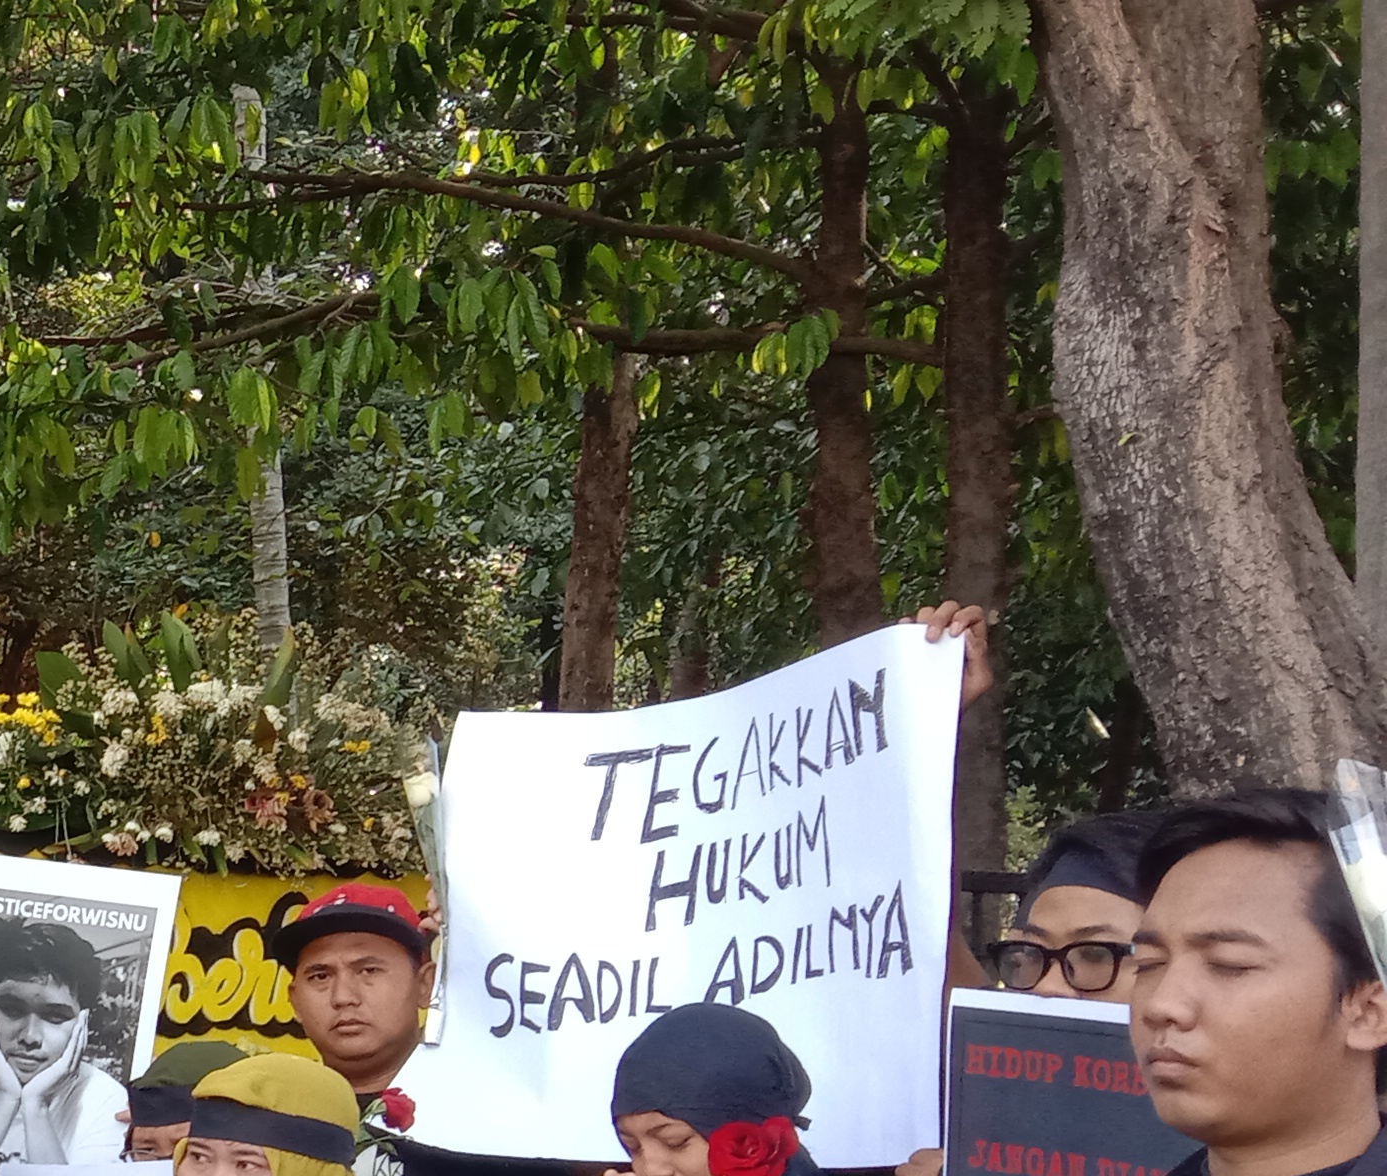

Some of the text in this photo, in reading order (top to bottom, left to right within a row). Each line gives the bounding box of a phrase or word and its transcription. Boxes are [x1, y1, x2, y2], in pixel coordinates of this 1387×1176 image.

[583, 668, 889, 844] TEGAKKAN
[645, 795, 831, 932] HUKUM
[484, 951, 673, 1039] SEADIL
[965, 1043, 1064, 1084] HIDUP
